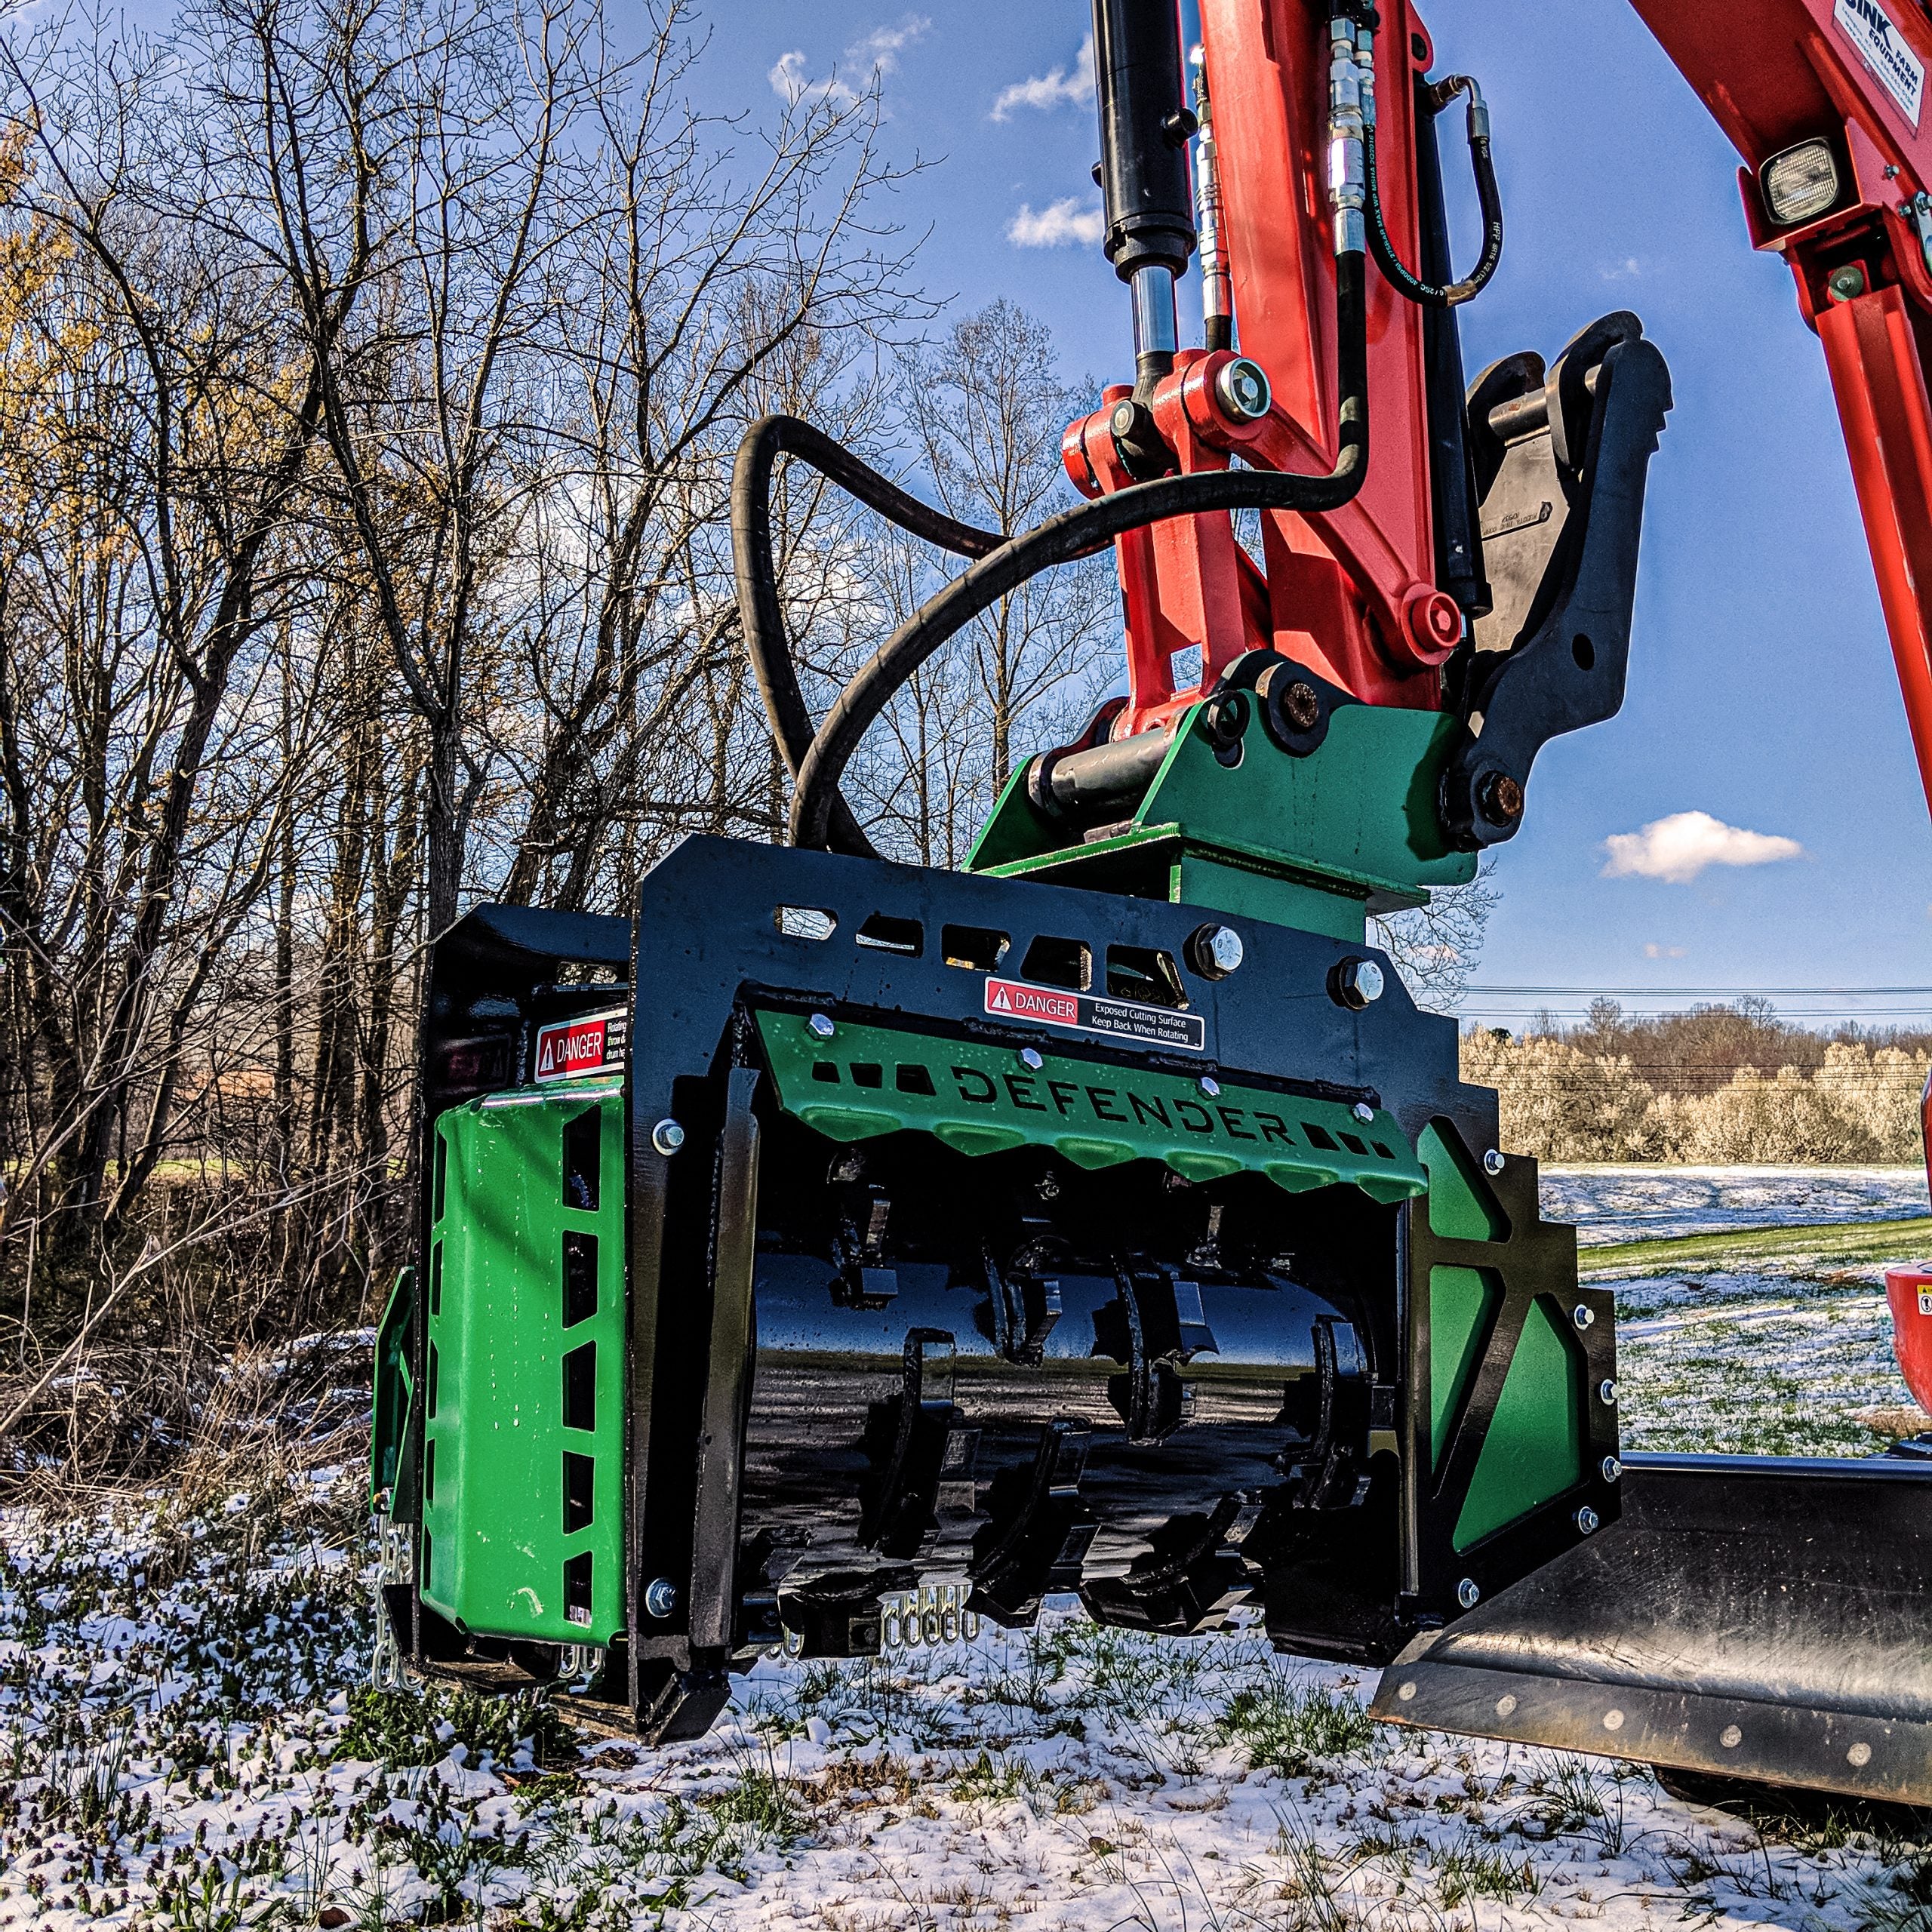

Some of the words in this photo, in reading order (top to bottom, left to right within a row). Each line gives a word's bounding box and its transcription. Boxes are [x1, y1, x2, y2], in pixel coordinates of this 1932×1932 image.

[1869, 27, 1916, 96] EQUIPMENT
[1896, 50, 1918, 85] FARM
[1372, 192, 1380, 207] WP
[1374, 208, 1383, 227] MAX
[1493, 221, 1501, 241] HPP
[1378, 229, 1396, 259] 275BAR
[1395, 262, 1418, 286] 4000PSI
[1015, 992, 1075, 1019] DANGER
[1095, 1002, 1128, 1017] Exposed
[1129, 1009, 1156, 1025] Cutting
[1158, 1014, 1186, 1028] Surface
[1092, 1016, 1112, 1028] Keep
[1113, 1020, 1132, 1031] Back
[1134, 1023, 1155, 1035] When
[1158, 1027, 1189, 1043] Rotating
[556, 1031, 601, 1063] DANGER
[950, 1066, 1297, 1146] DEFENDER
